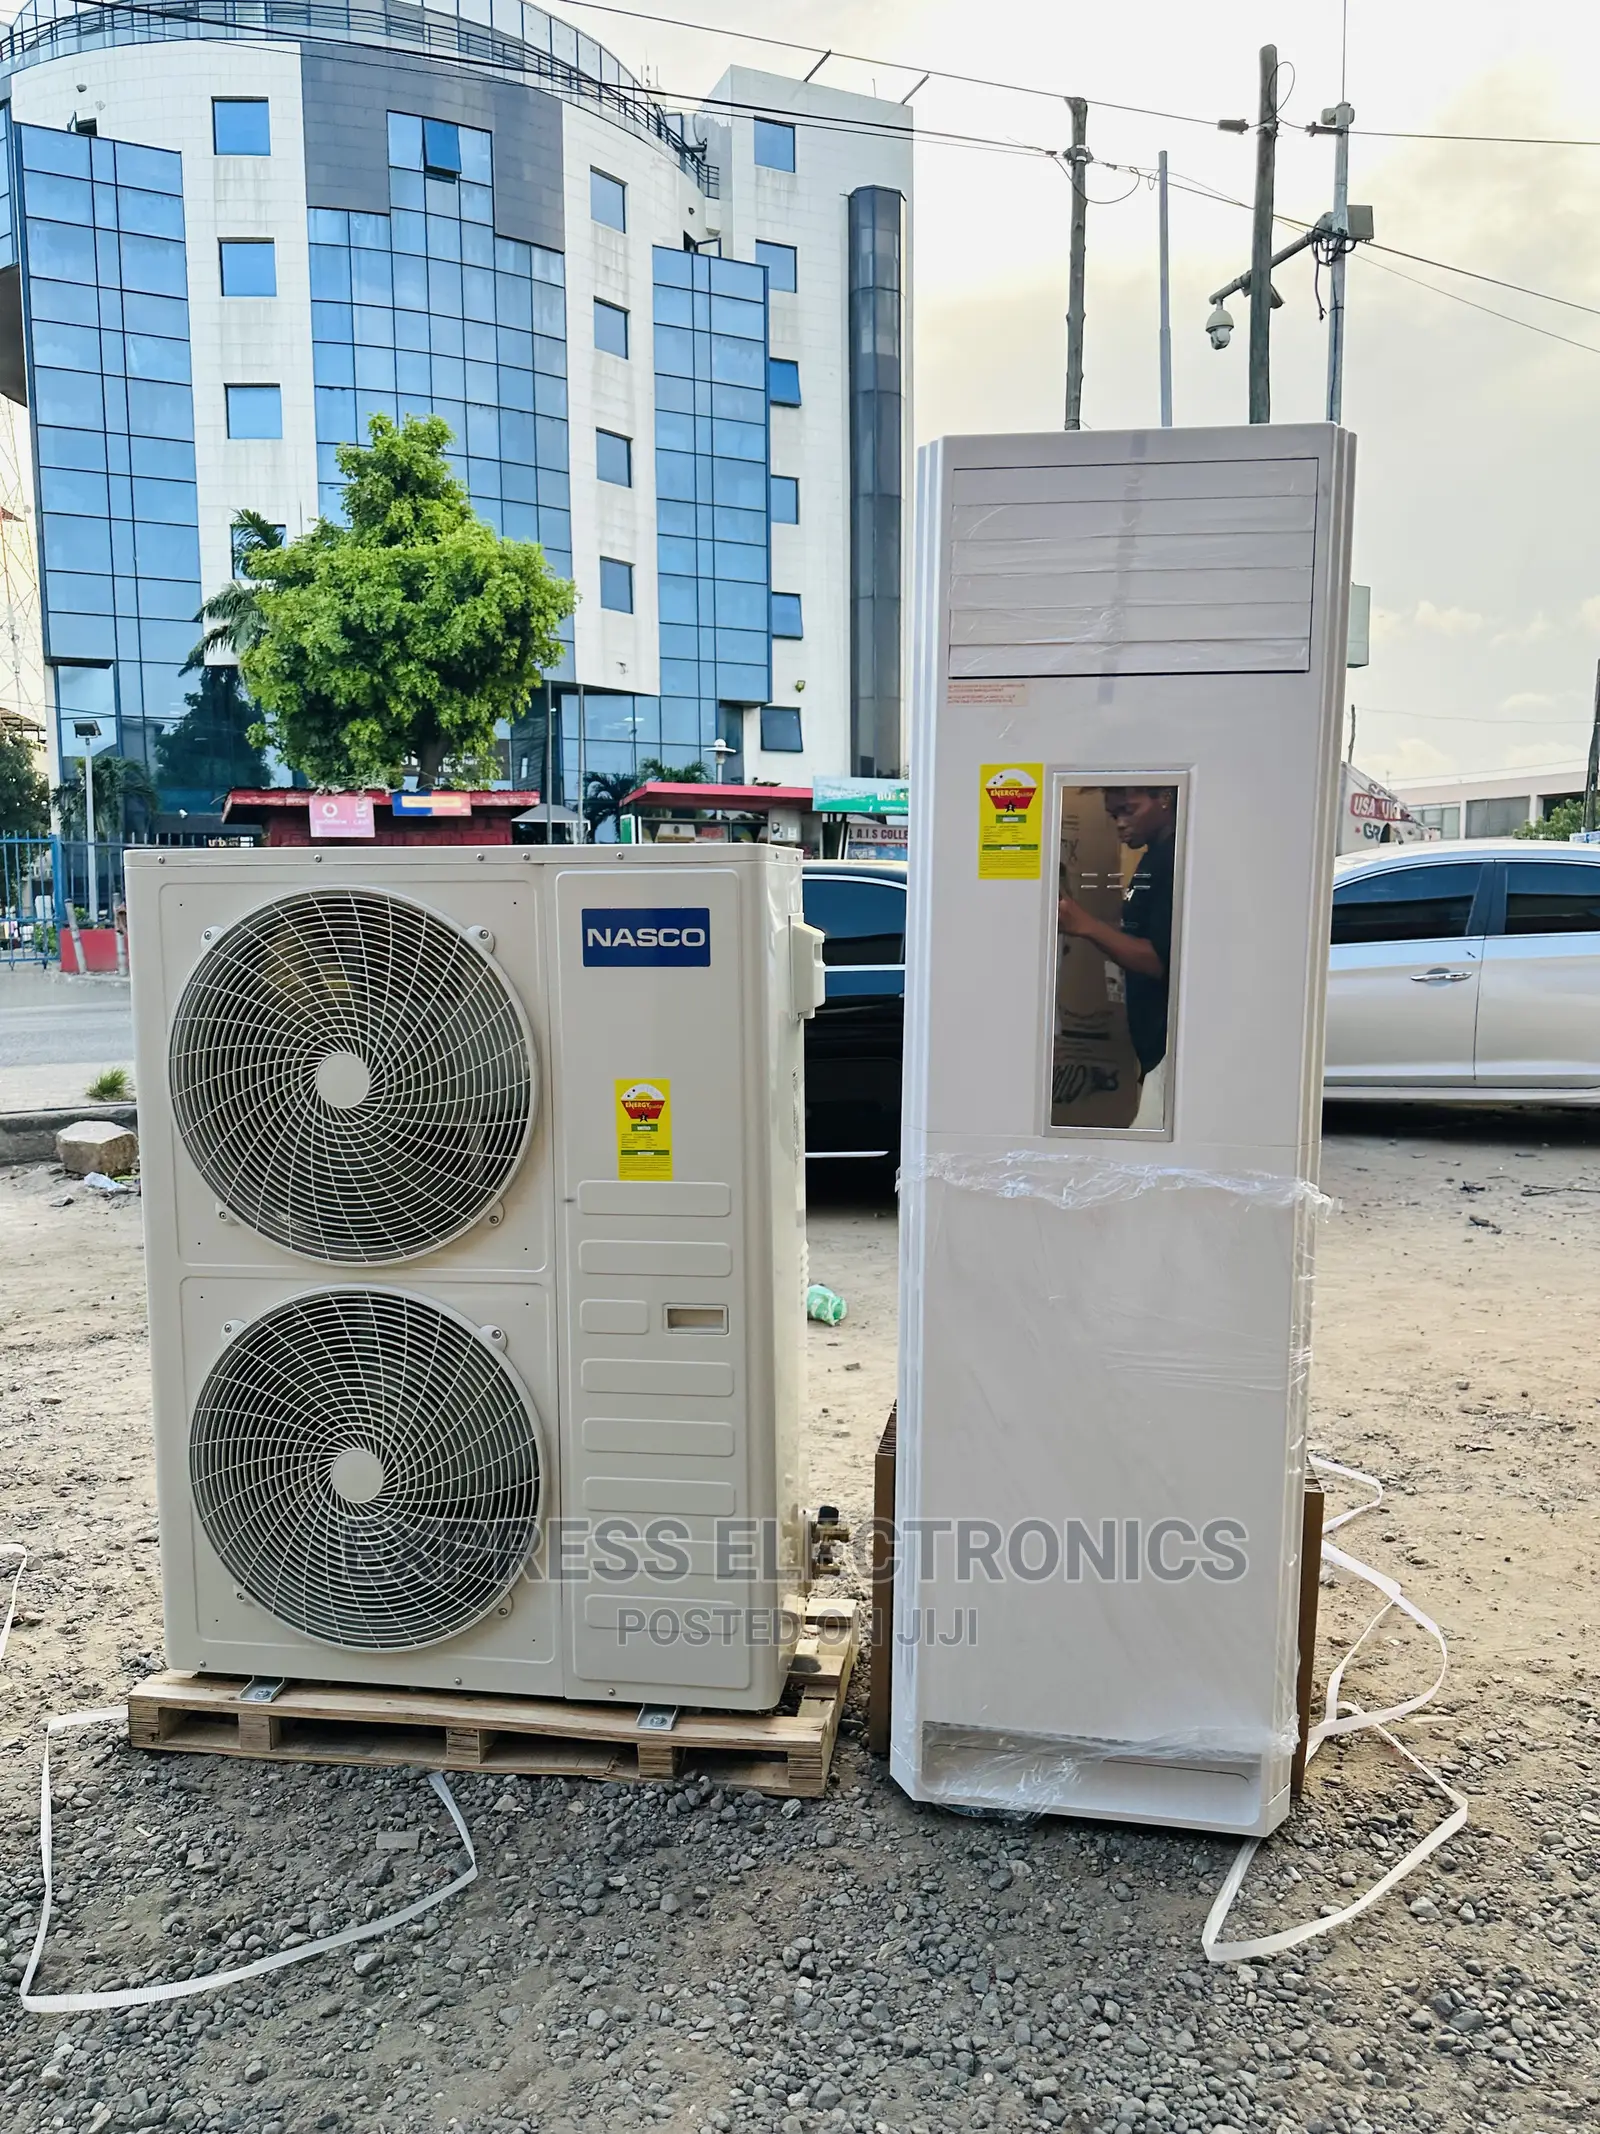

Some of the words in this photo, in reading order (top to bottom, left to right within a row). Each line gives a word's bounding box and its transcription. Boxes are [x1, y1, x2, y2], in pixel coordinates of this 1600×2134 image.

[990, 789, 1019, 798] ENERGY
[1354, 796, 1376, 817] USA
[587, 928, 706, 947] NASCO
